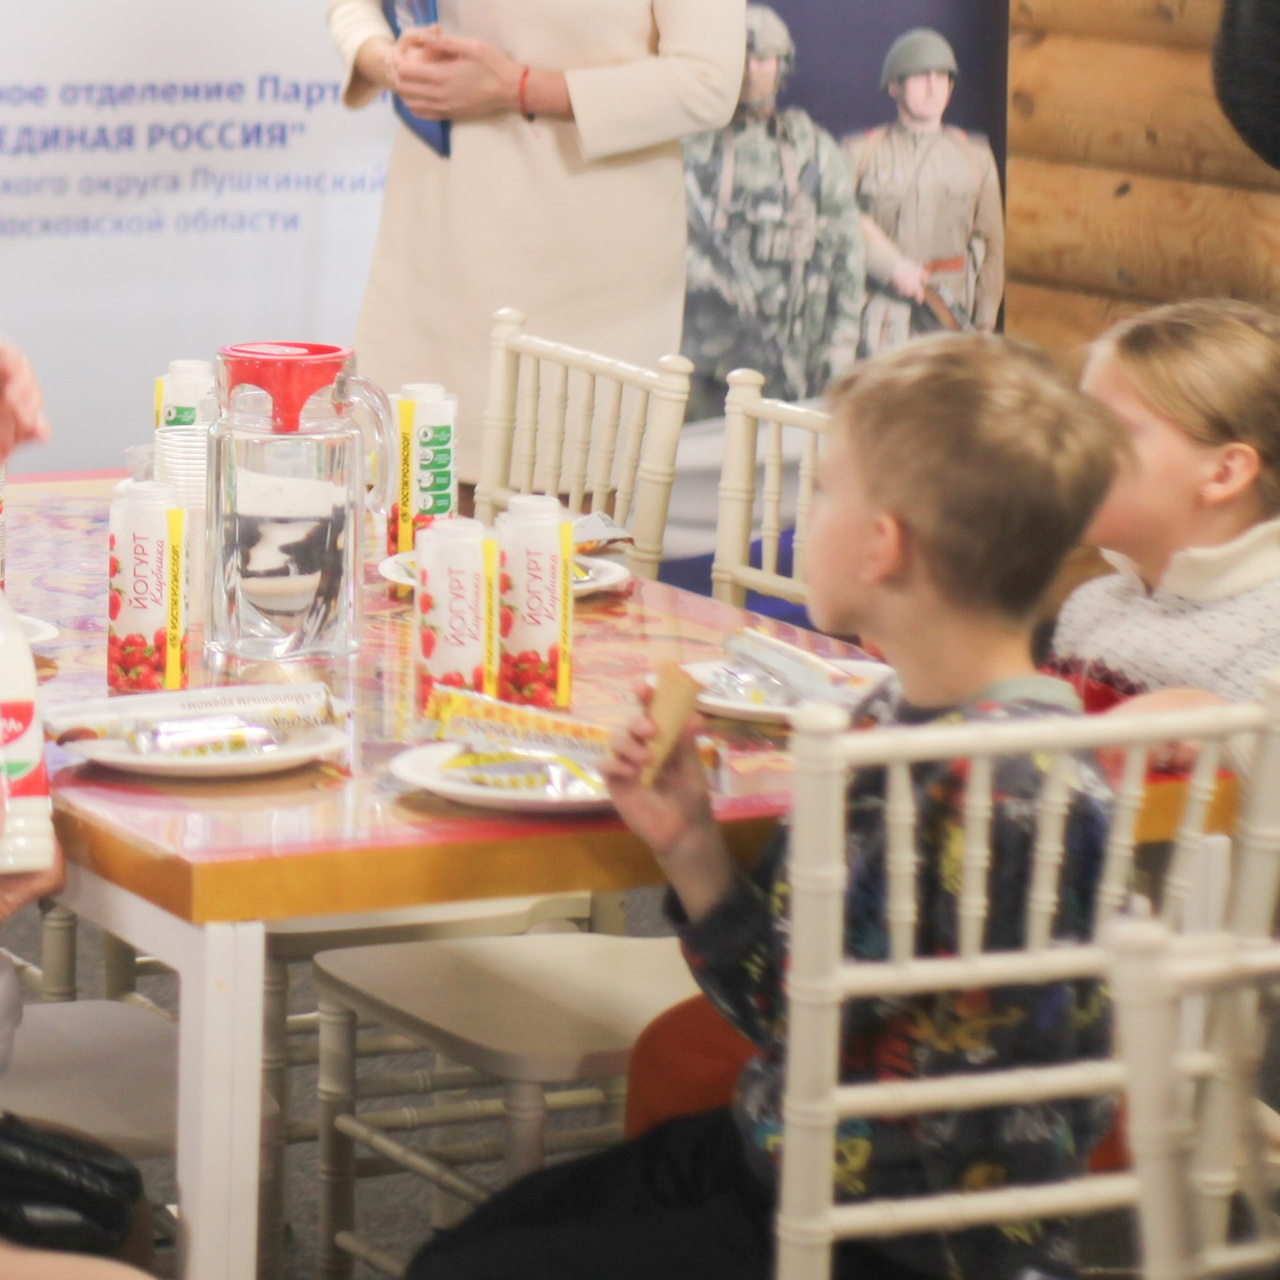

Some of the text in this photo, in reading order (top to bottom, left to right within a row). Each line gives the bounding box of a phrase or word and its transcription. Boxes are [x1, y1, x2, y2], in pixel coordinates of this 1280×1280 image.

[60, 80, 245, 110] отделение
[258, 75, 342, 111] Парт
[128, 532, 149, 611] ЙОГУРТ
